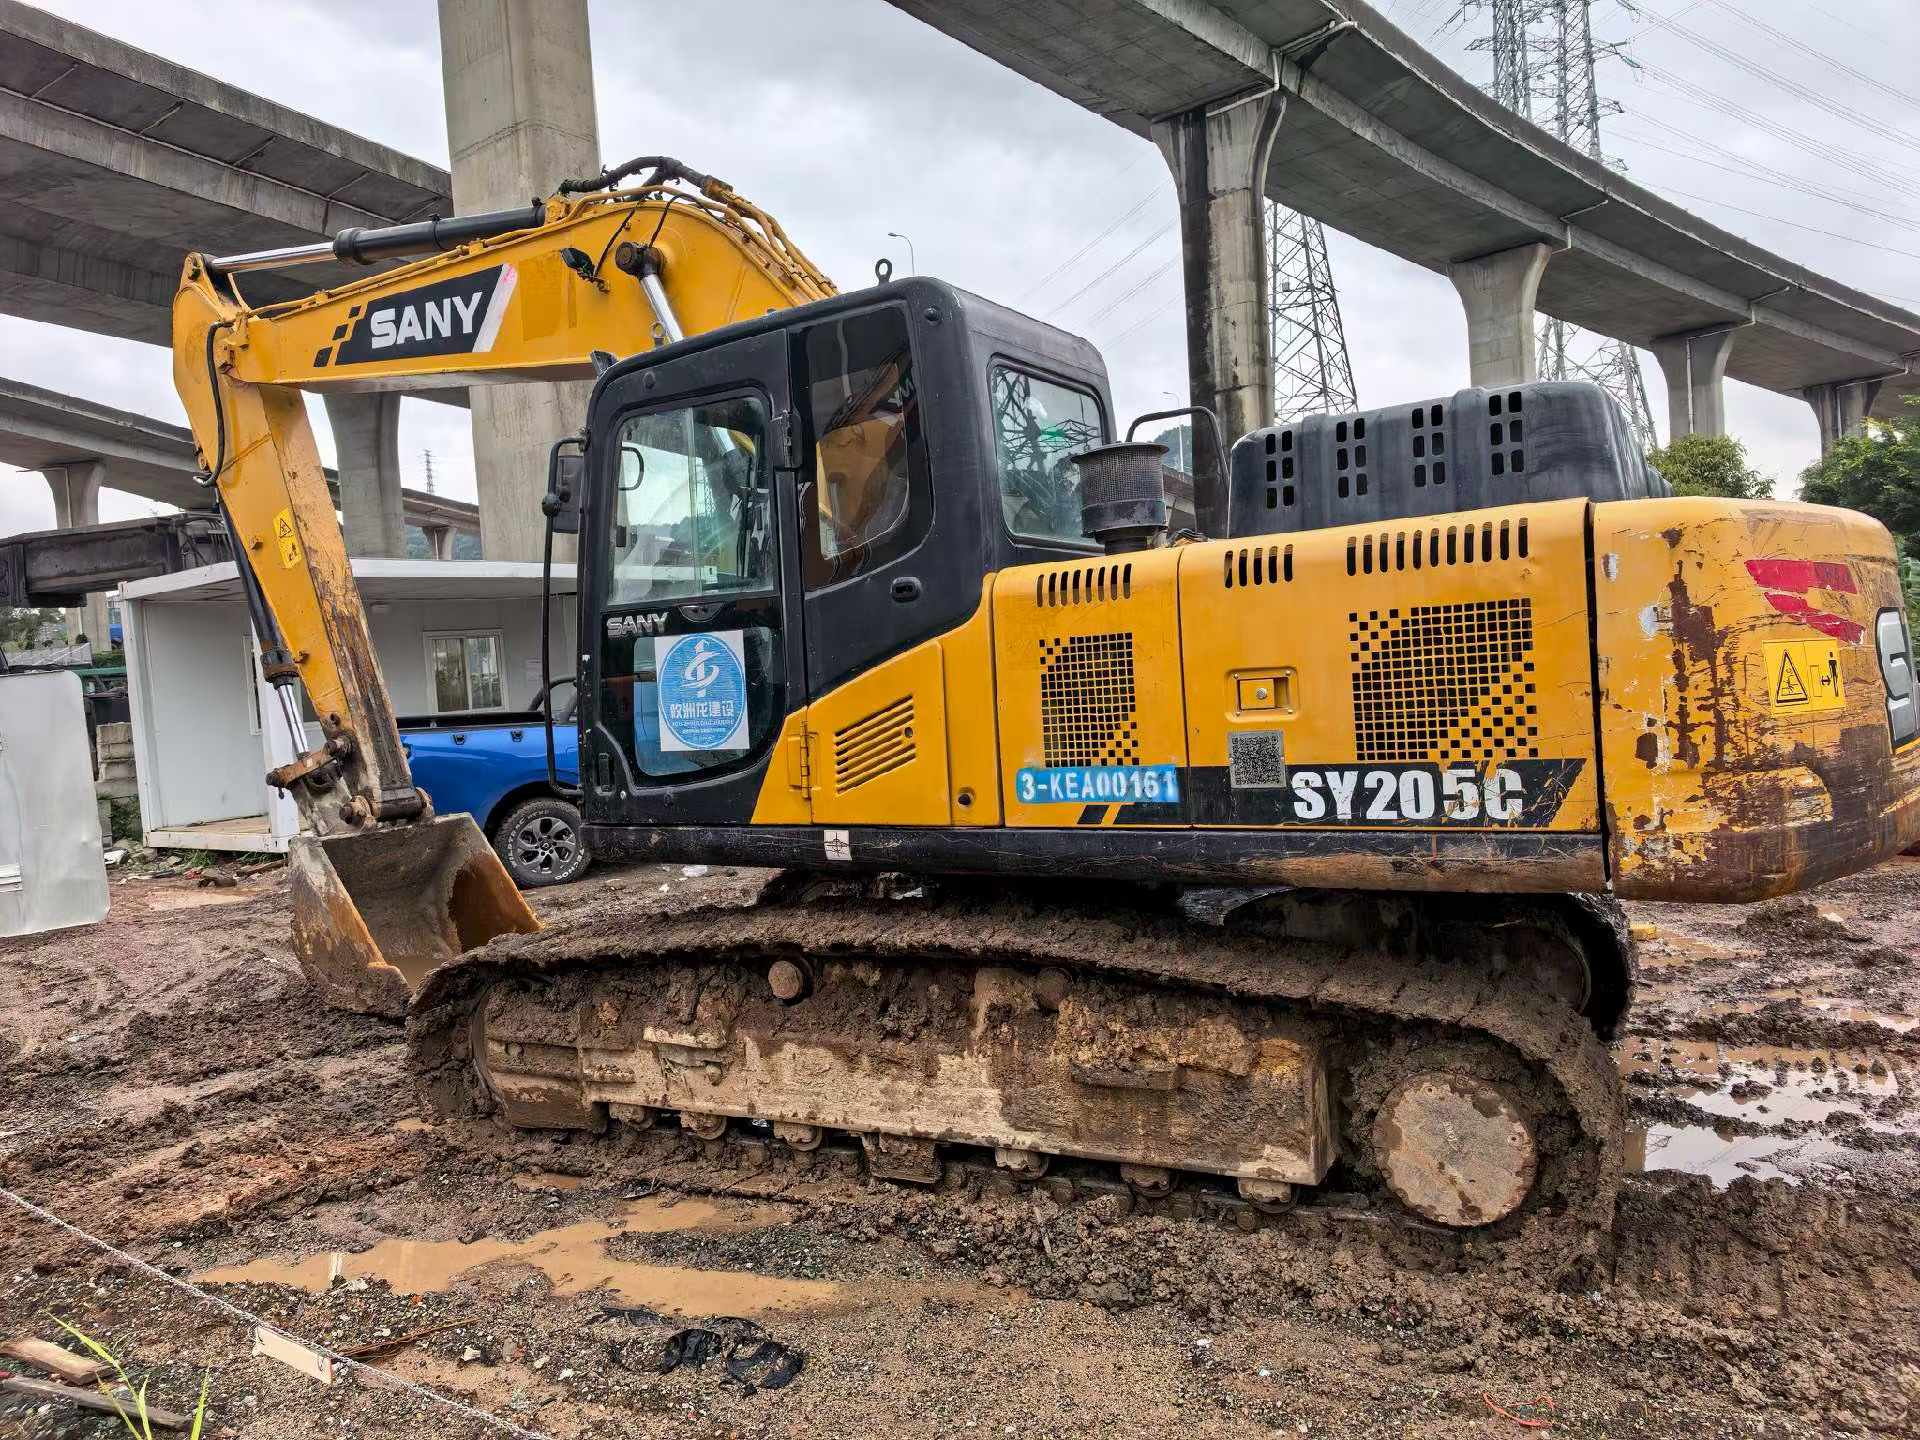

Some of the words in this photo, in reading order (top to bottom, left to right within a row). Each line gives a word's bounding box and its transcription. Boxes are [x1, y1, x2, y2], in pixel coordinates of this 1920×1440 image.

[370, 291, 482, 349] SANY
[606, 612, 669, 637] SANY
[1291, 768, 1523, 819] SY205C
